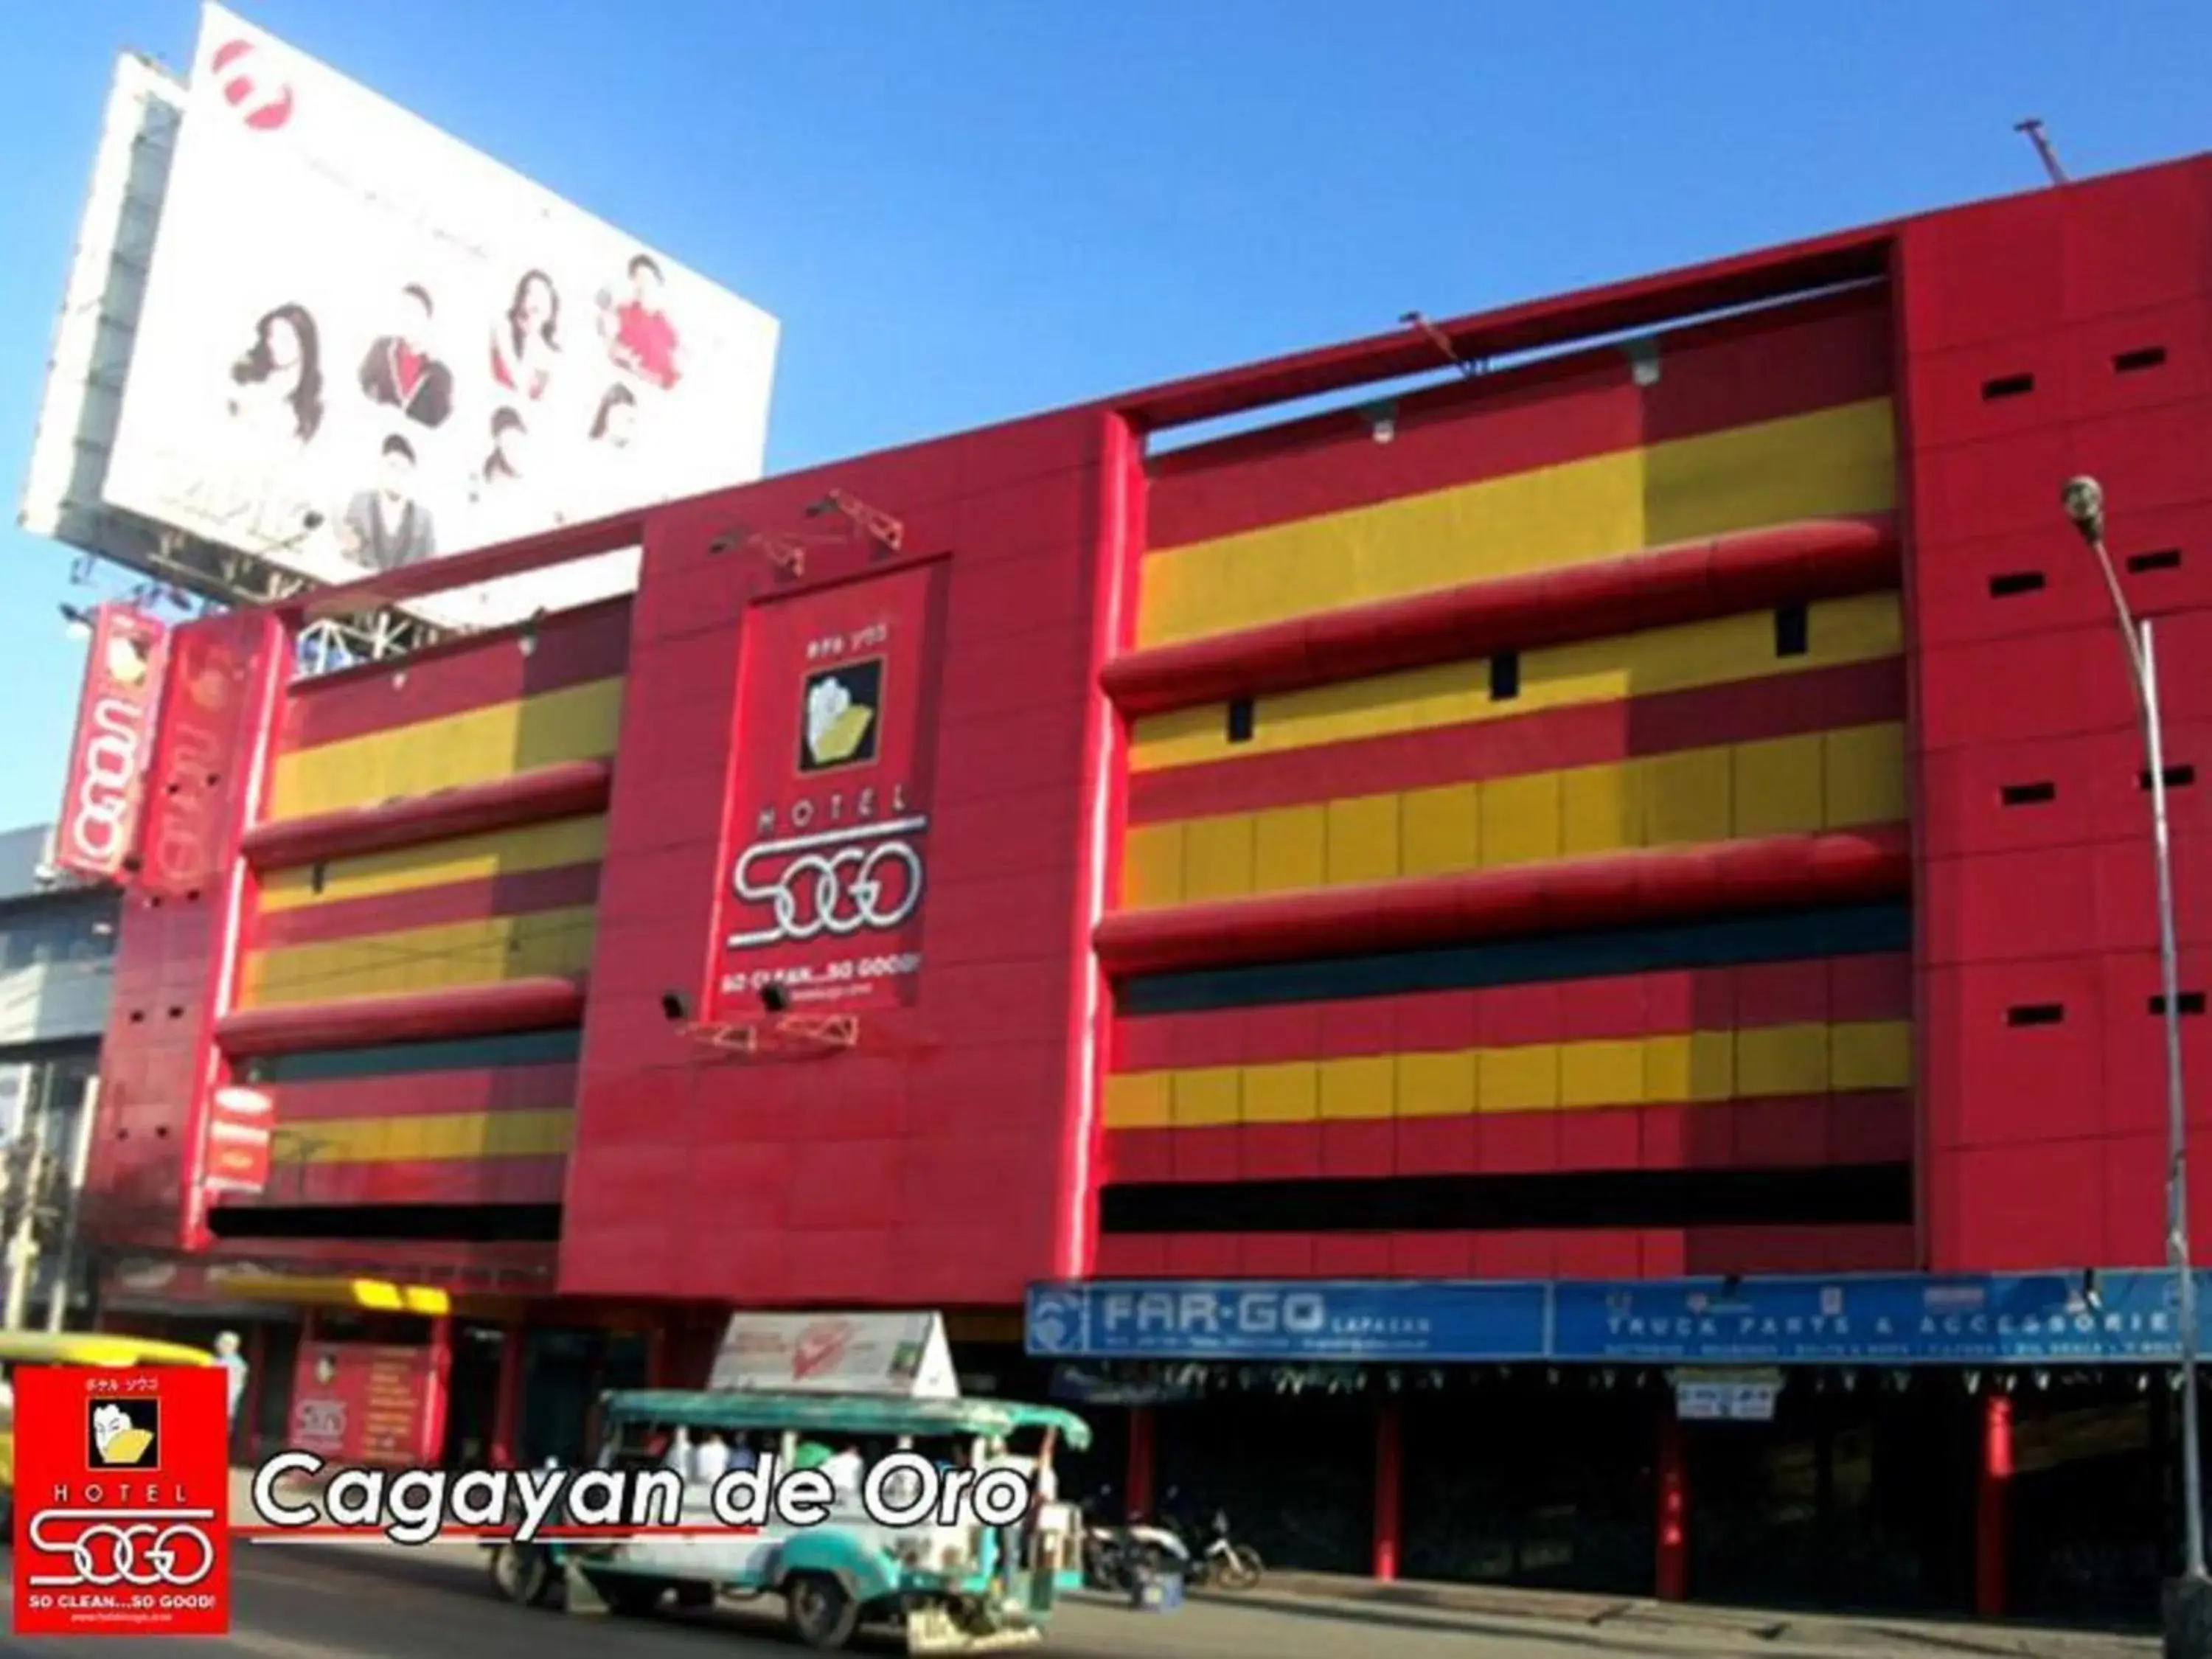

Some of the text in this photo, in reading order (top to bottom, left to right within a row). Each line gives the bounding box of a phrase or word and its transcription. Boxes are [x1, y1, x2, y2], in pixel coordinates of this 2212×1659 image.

[757, 784, 905, 831] HOTEL
[727, 814, 928, 947] SOGO
[1606, 1315, 1717, 1337] TRUCK
[1739, 1315, 1848, 1335] PARTS
[1920, 1310, 2191, 1335] ACCESSORIE
